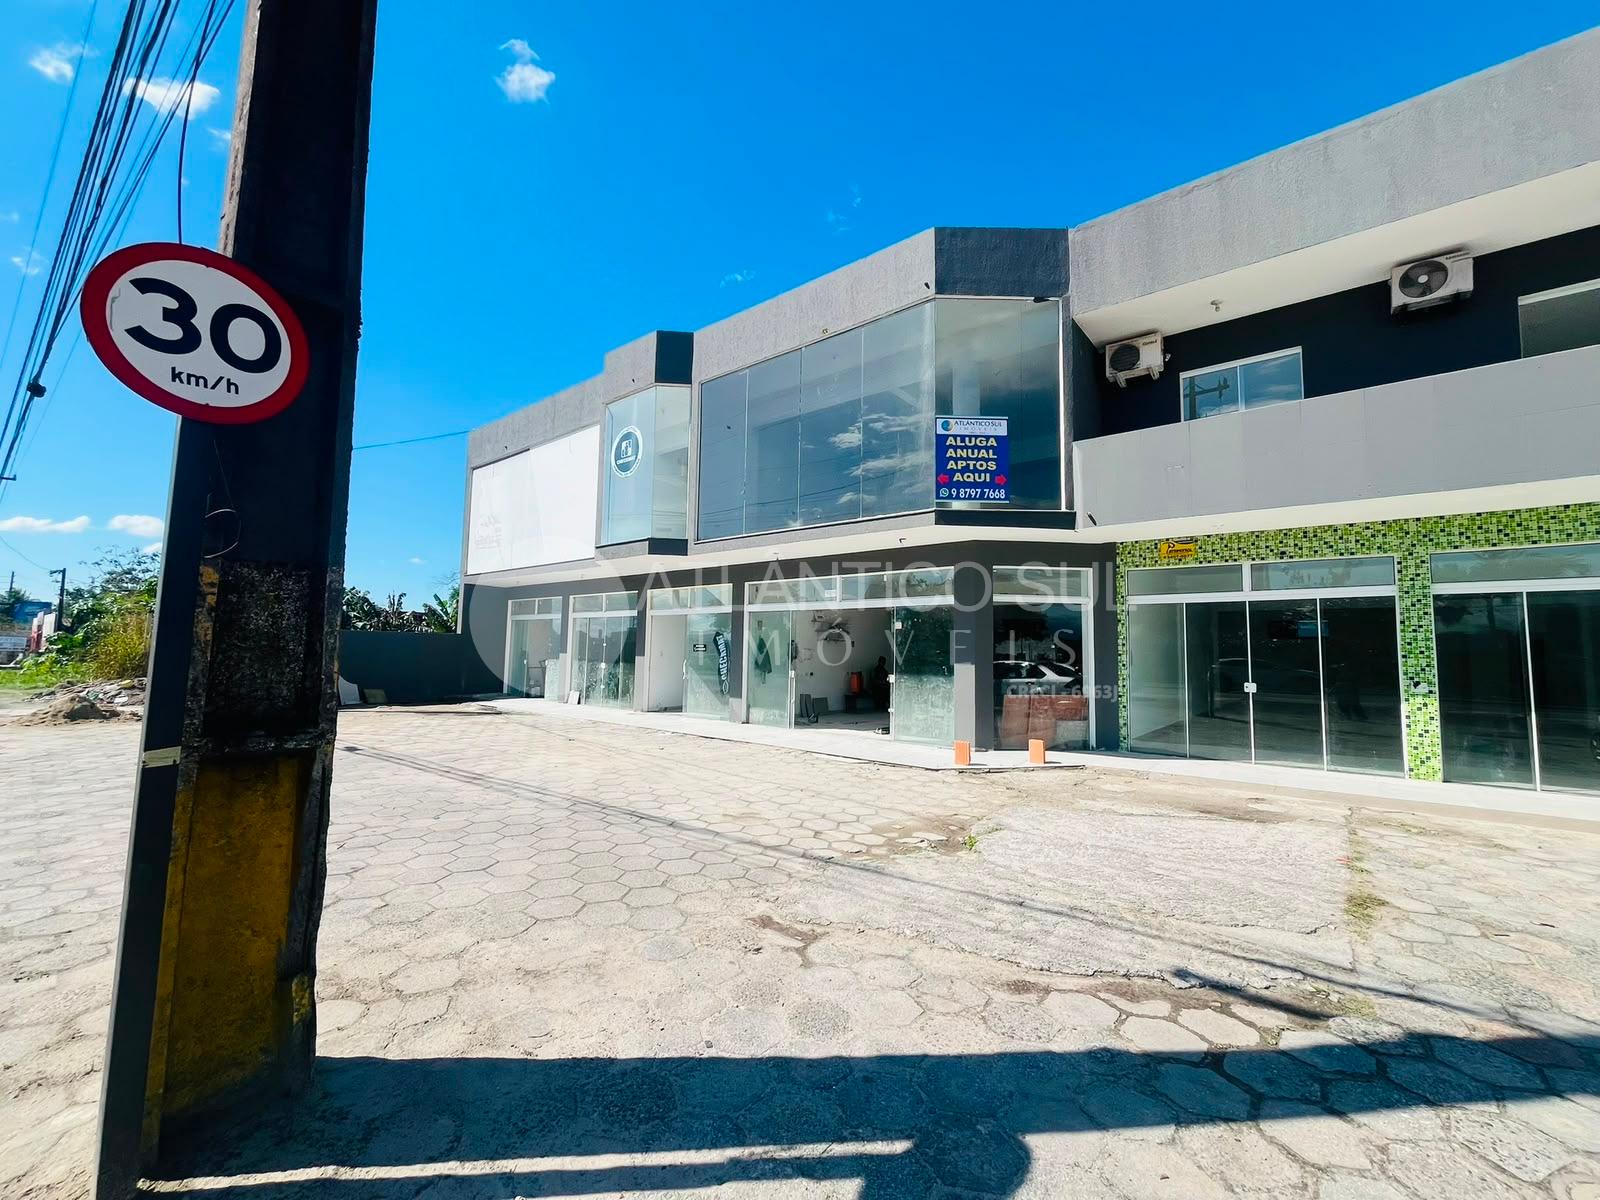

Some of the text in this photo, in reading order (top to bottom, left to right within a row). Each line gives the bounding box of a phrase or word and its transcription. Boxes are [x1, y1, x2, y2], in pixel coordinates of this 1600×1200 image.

[125, 278, 282, 374] 30
[171, 367, 239, 395] km/h
[946, 436, 997, 447] ALUGA
[946, 448, 998, 459] ANUAL
[947, 460, 997, 471] APTOS
[953, 472, 990, 482] AQUI
[951, 488, 1006, 499] 9 8797 7668
